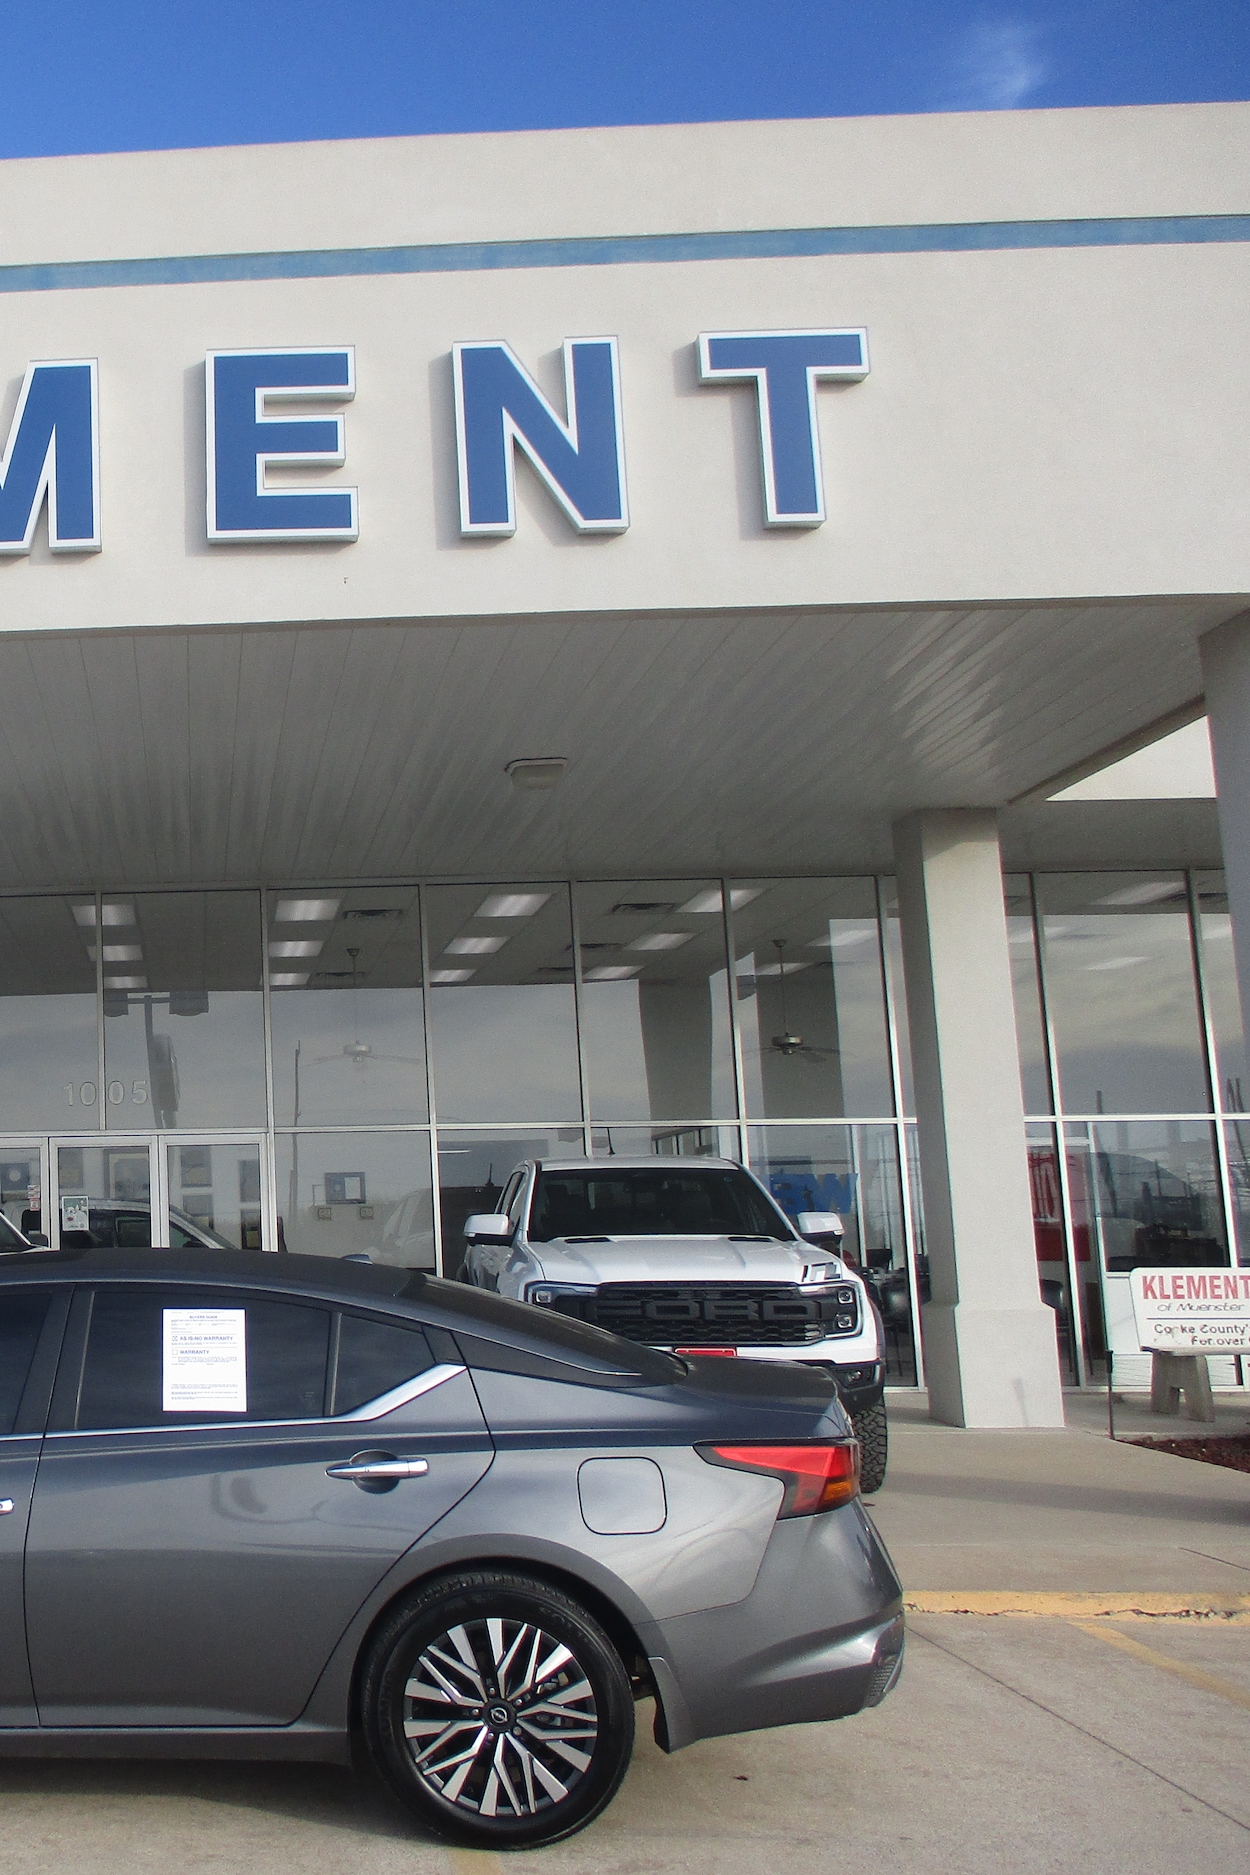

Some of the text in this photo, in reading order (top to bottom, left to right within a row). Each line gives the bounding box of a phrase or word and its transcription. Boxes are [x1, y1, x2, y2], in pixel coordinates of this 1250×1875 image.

[62, 1080, 148, 1107] 1005
[1141, 1275, 1250, 1300] KLEMENT
[584, 1299, 817, 1321] FORD
[1157, 1302, 1245, 1312] of Muenster
[1154, 1324, 1250, 1336] Coke County'
[1216, 1337, 1245, 1346] over
